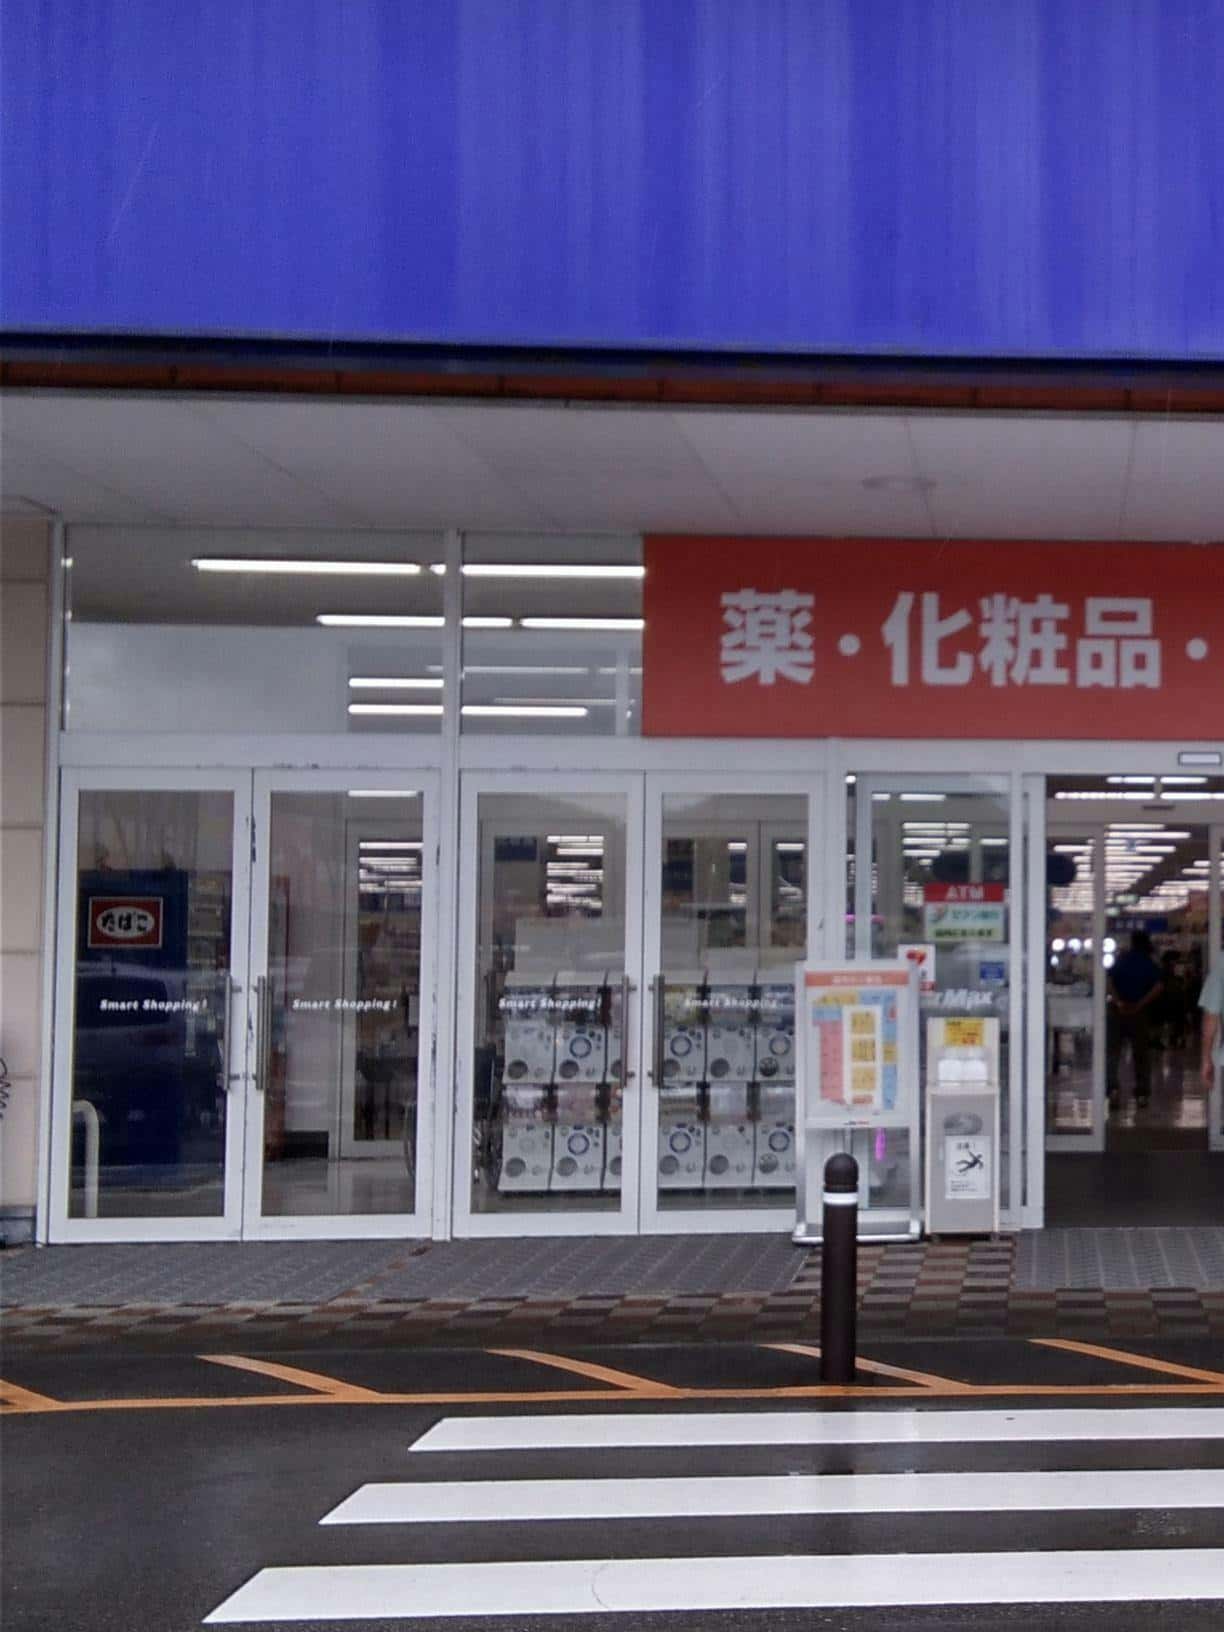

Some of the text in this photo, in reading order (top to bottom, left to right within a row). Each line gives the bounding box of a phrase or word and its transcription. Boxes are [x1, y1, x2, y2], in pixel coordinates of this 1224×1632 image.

[944, 885, 985, 899] ATM
[101, 911, 149, 933] たばこ
[100, 999, 139, 1011] Smart
[292, 999, 330, 1011] Smart
[498, 998, 536, 1010] Smart
